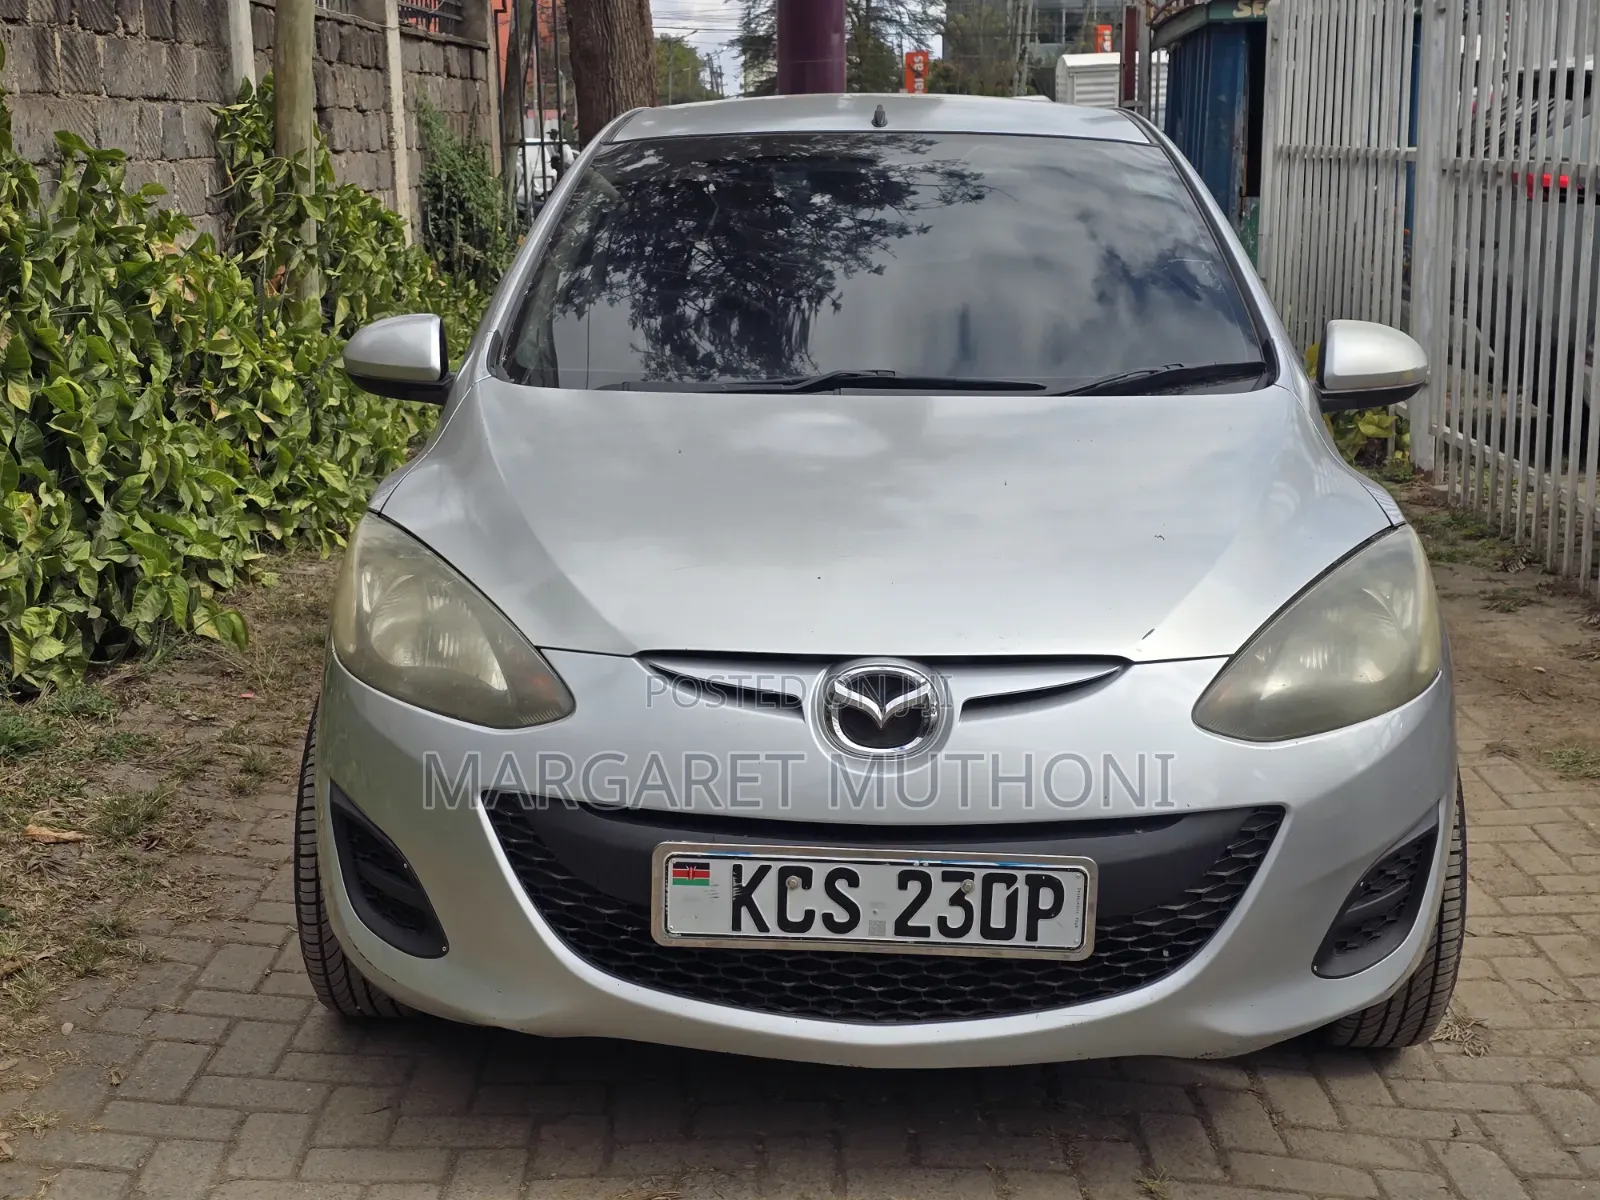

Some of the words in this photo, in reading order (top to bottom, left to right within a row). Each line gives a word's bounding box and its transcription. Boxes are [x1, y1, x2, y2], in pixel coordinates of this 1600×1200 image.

[1233, 0, 1270, 18] SE
[731, 863, 861, 934] KCS
[894, 869, 1065, 942] 230P
